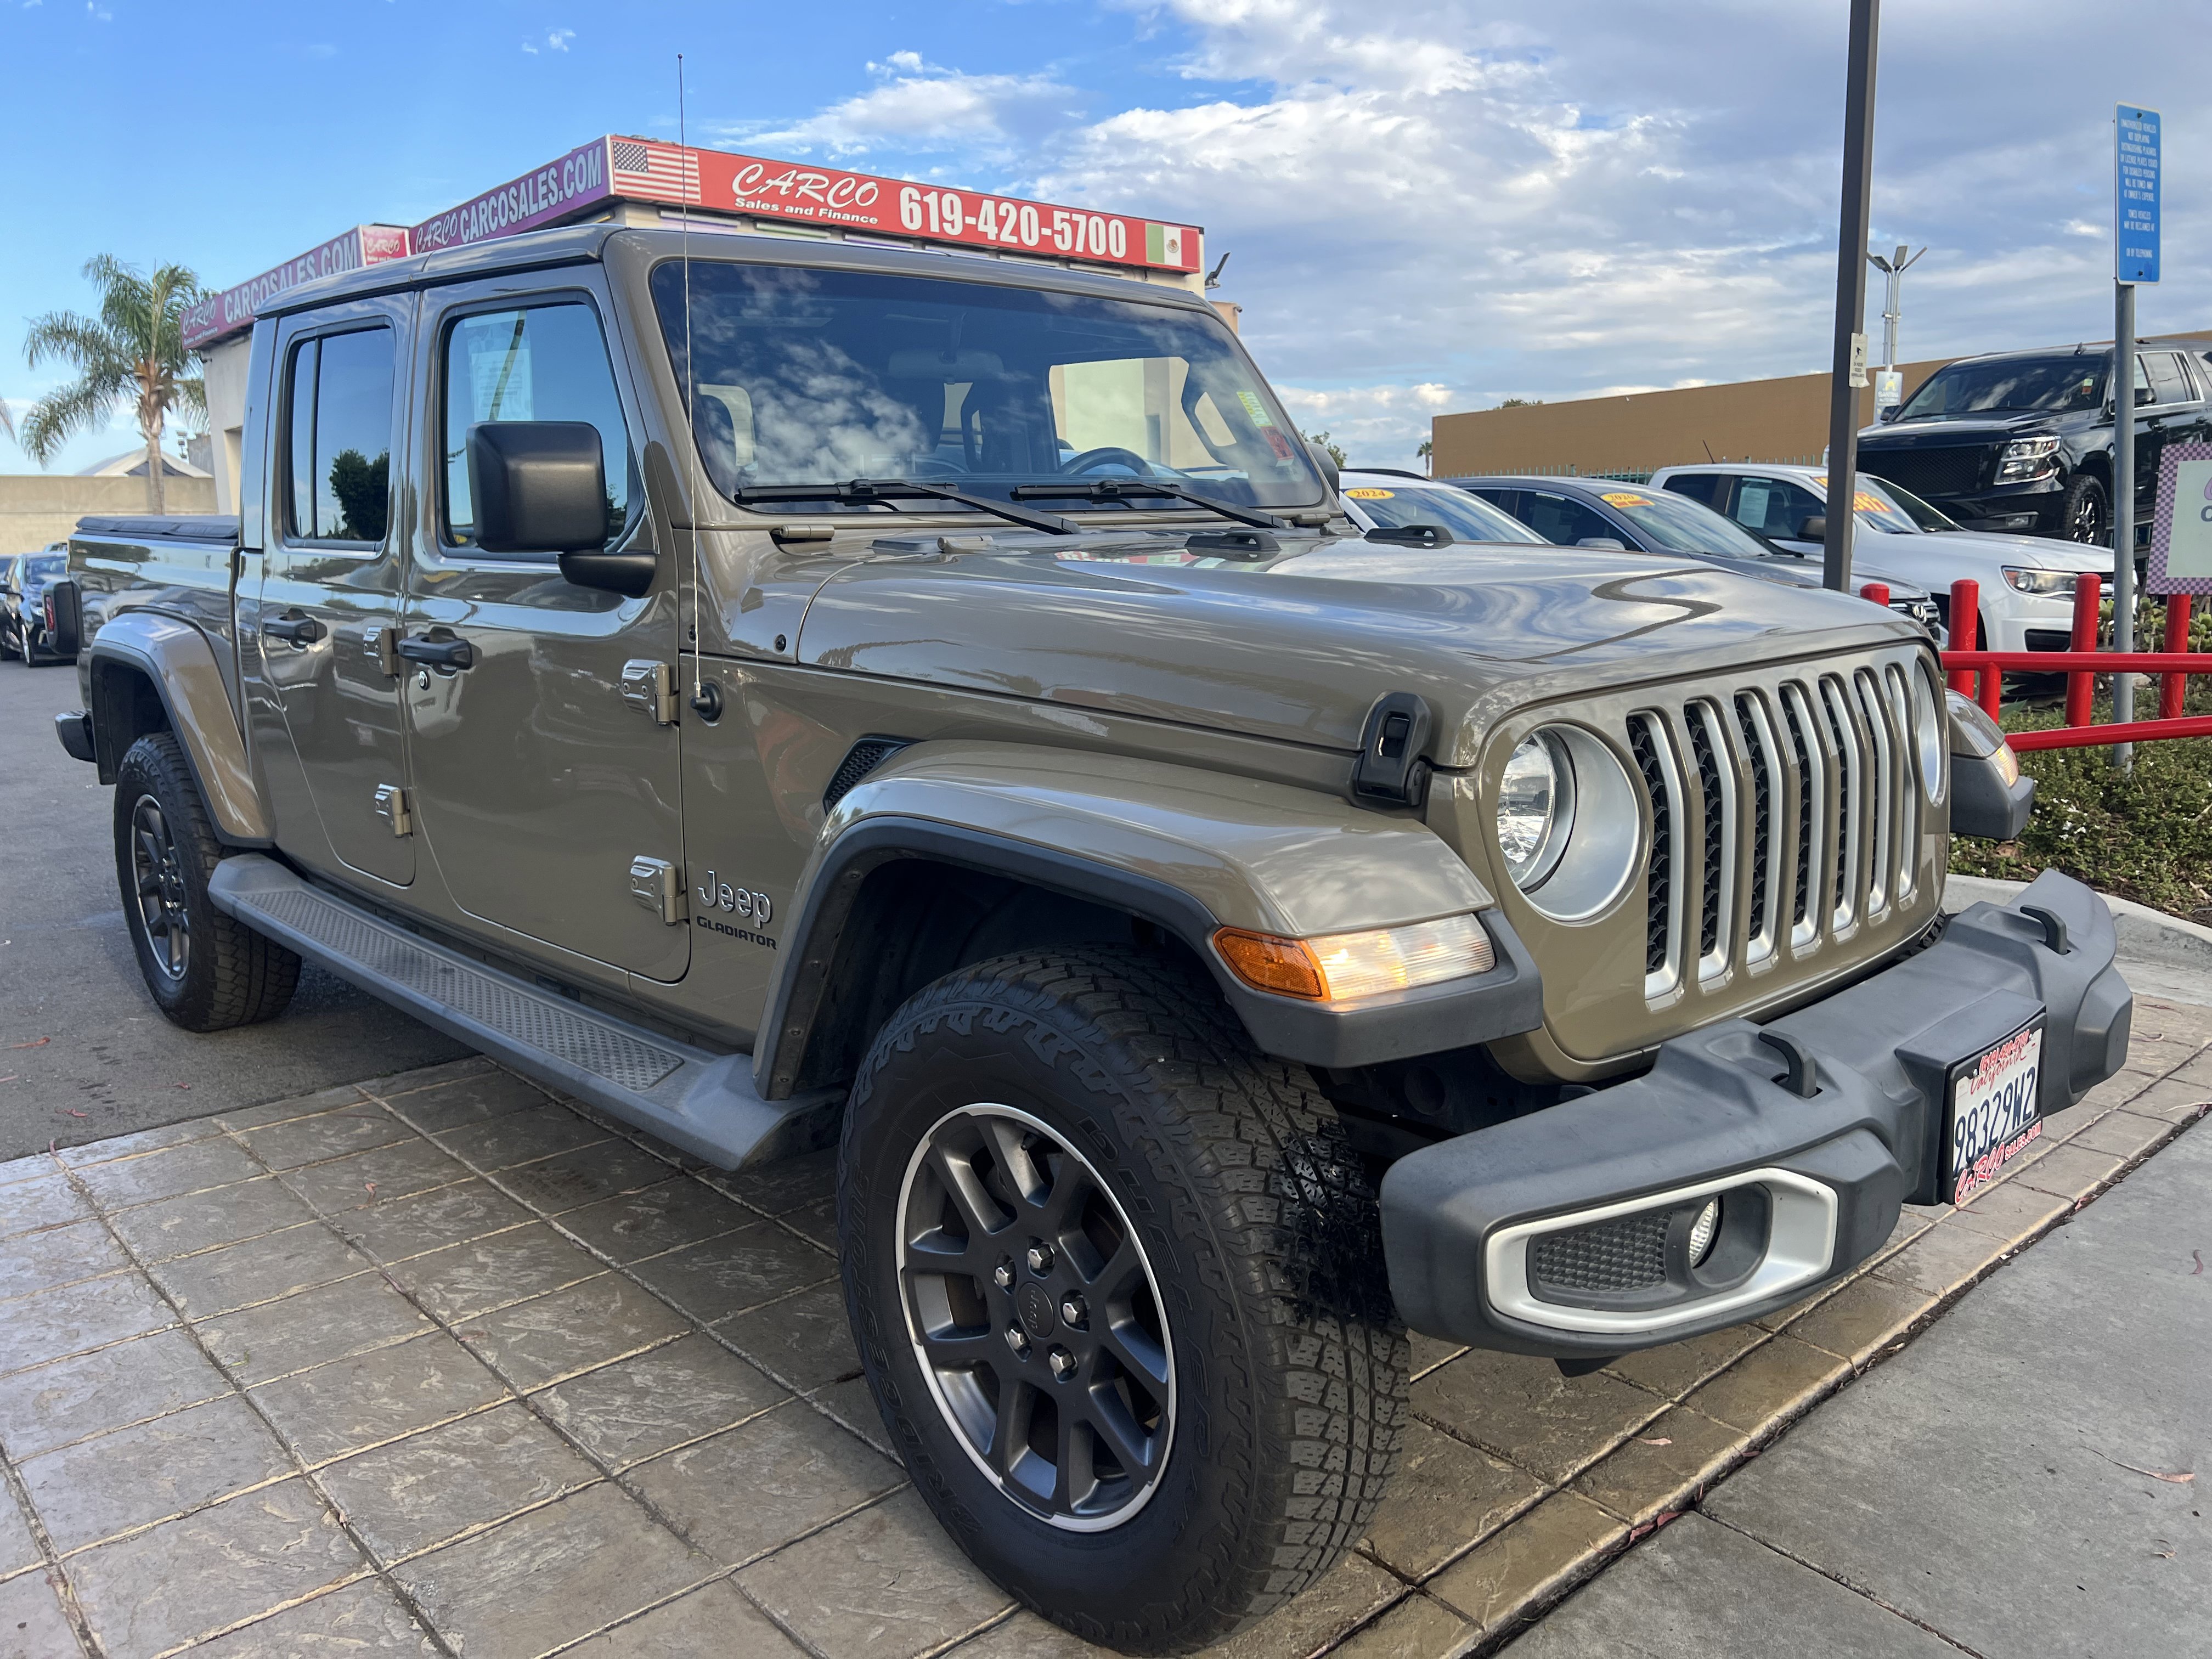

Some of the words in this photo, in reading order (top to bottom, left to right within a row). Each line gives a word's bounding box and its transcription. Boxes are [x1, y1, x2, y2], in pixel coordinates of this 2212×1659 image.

[459, 145, 602, 243] CARCOSALES.COM
[732, 163, 878, 208] CARCO
[735, 197, 780, 212] Sales
[785, 205, 814, 216] and
[818, 207, 878, 225] Finance
[899, 186, 1126, 258] 619-420-5700
[366, 238, 400, 255] CARCO
[415, 212, 458, 255] CARCO
[183, 299, 216, 335] CARCO
[697, 870, 772, 929] Jeep
[696, 915, 777, 950] GLADIATOR
[1953, 1066, 2035, 1180] 98329W2
[1954, 1141, 2005, 1205] CARCO
[2005, 1120, 2042, 1161] SALES.COM
[1028, 1289, 1040, 1329] Jeep
